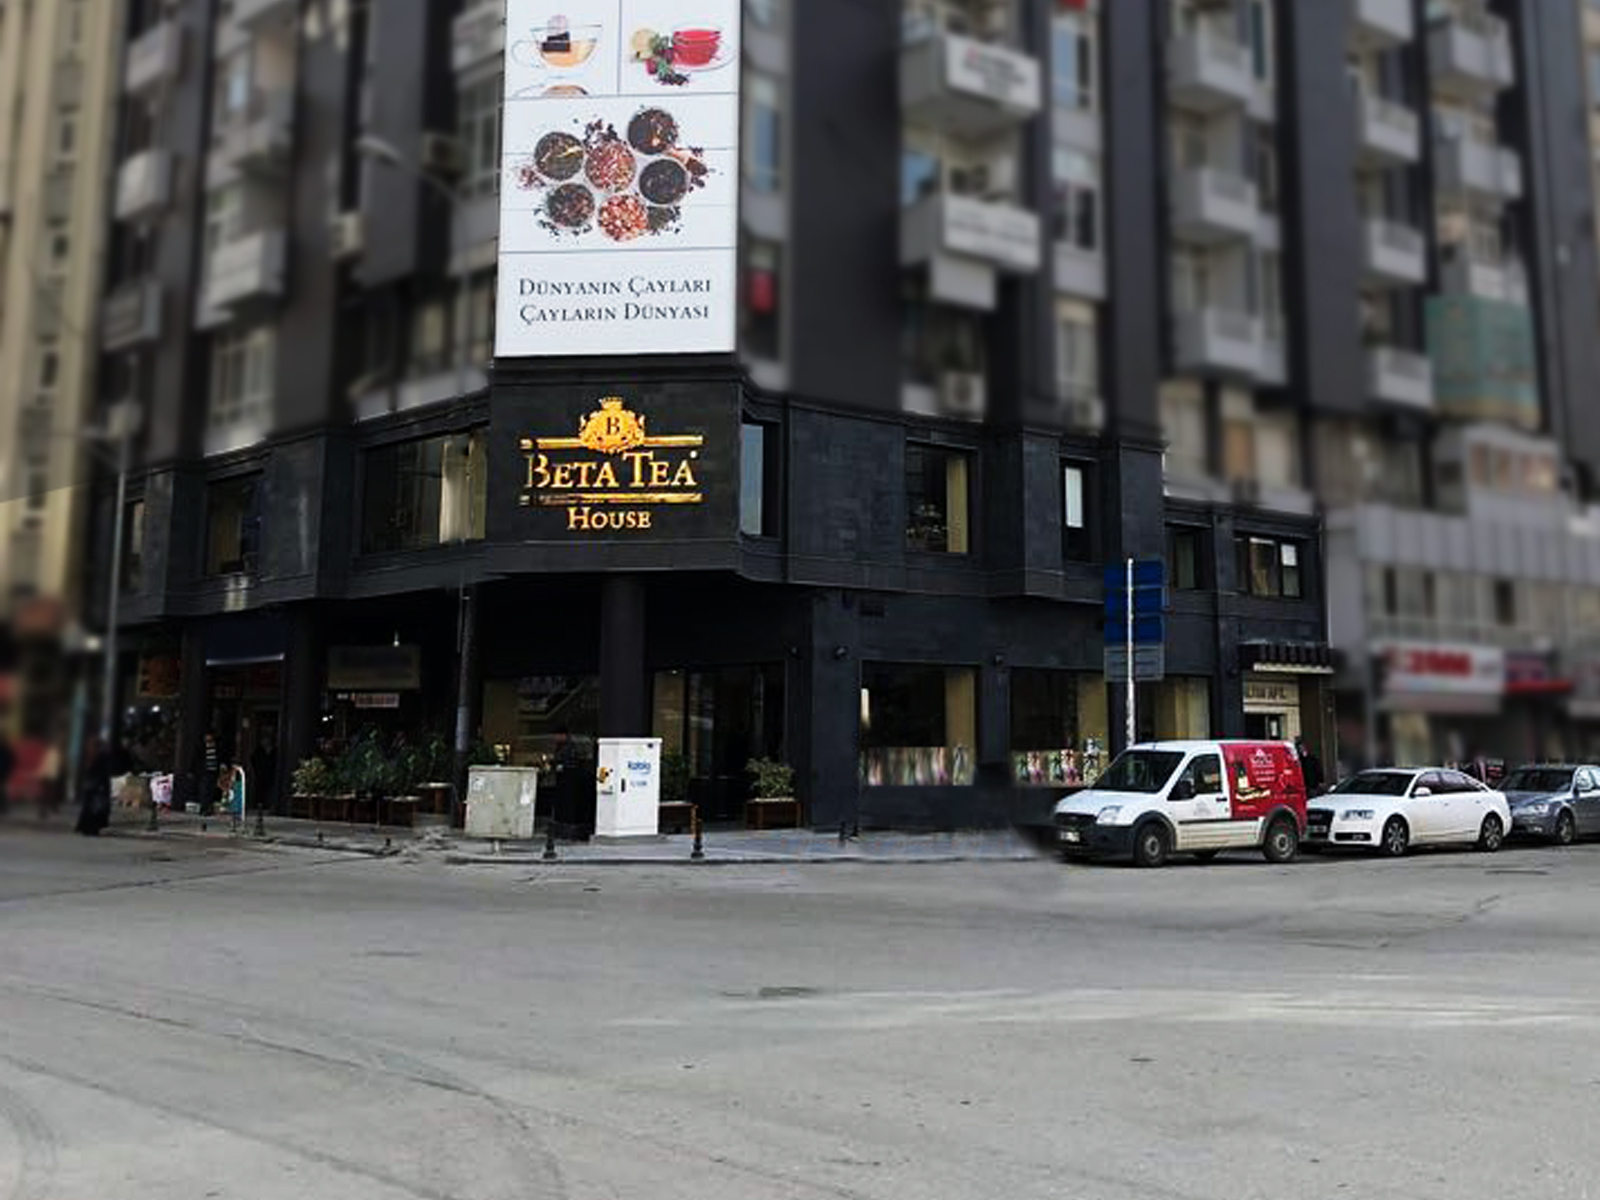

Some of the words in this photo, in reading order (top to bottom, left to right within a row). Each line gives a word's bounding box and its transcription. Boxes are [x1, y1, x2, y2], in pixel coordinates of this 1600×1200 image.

[519, 277, 622, 296] DÜNYANIN
[628, 275, 711, 297] ÇAYLARI
[519, 303, 617, 326] ÇAYLARIN
[624, 302, 710, 320] DÜNYASI
[605, 416, 621, 436] B
[524, 452, 620, 488] BETA
[622, 450, 698, 488] TEA
[566, 506, 652, 530] HOUSE
